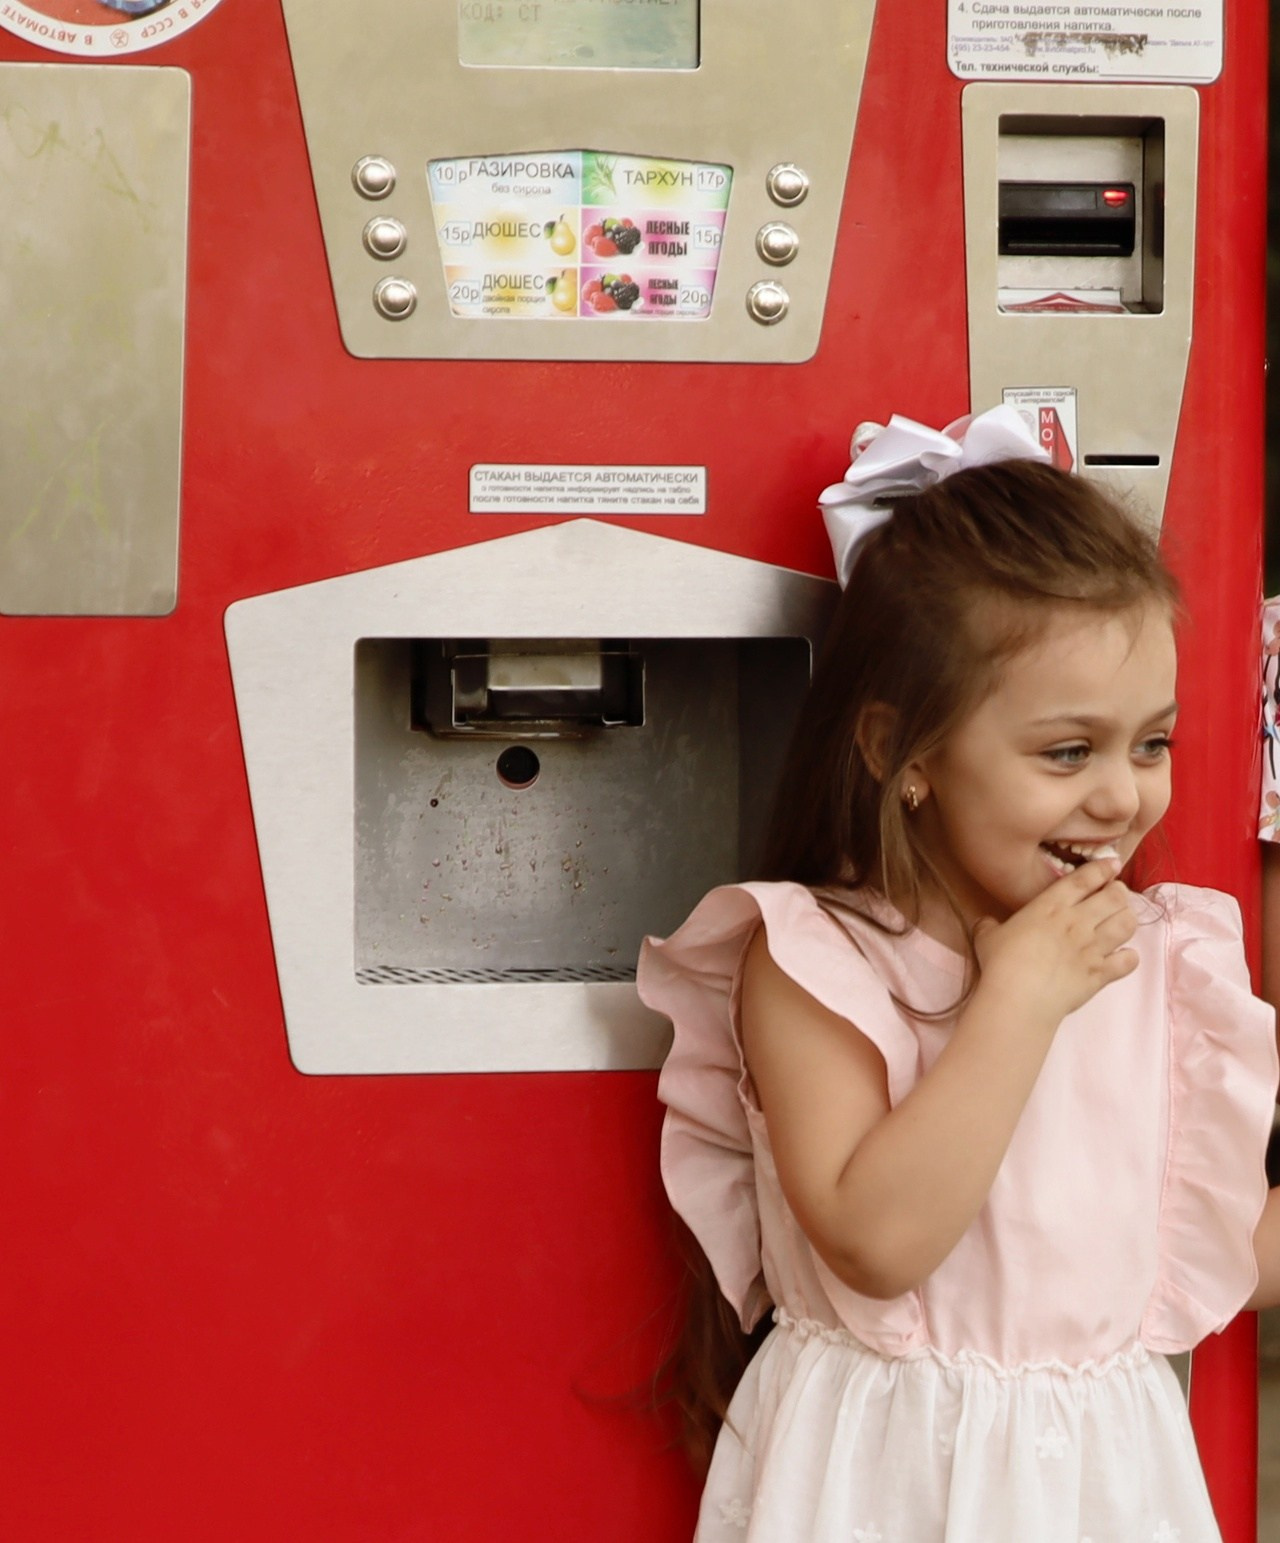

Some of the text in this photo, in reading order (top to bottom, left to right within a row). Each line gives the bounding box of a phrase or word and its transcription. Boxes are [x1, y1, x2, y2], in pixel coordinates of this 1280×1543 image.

[958, 3, 1202, 18] 4. Сдача выдается автоматически после
[1, 5, 93, 45] В АВТОМАТЕ
[140, 17, 174, 38] СССР
[972, 19, 1115, 31] приготовления напитка.
[955, 61, 1099, 75] Тел. технической службы:
[436, 166, 454, 180] 10
[468, 160, 575, 179] ГАЗИРОВКА
[623, 170, 693, 186] ТАРХУН
[698, 171, 724, 188] 17р
[491, 183, 510, 193] без
[444, 225, 470, 244] 15р
[473, 221, 541, 239] ДЮШЕС
[646, 220, 690, 236] ЛЕСНЫЕ
[696, 229, 722, 245] 15р
[648, 241, 688, 256] ЯГОДЫ
[482, 273, 544, 291] ДЮШЕС
[452, 285, 479, 301] 20р
[681, 289, 709, 307] 20р
[474, 470, 698, 483] СТАКАН ВЫДАЕТСЯ АВТОМАТИЧЕСКИ
[473, 495, 501, 503] после
[503, 495, 554, 503] готовности
[597, 496, 629, 504] тяните
[630, 496, 662, 504] стакан
[664, 496, 676, 504] на
